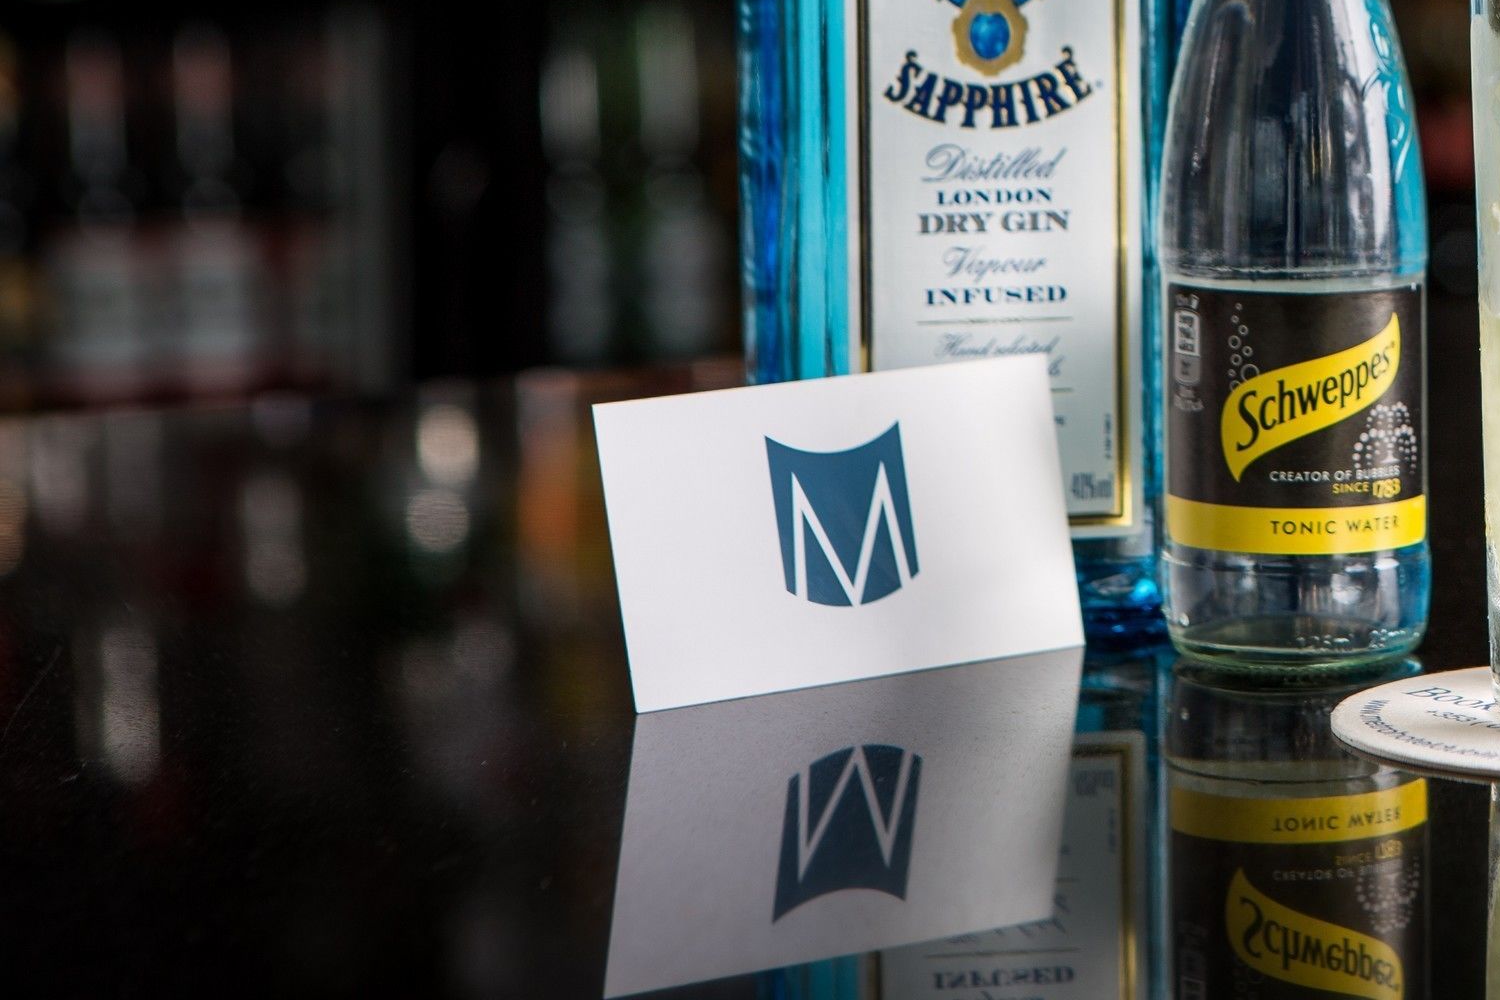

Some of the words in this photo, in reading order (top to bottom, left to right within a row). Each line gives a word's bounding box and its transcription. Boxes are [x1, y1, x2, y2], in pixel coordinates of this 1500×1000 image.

[883, 46, 1092, 129] SAPPHIRE
[922, 143, 1068, 183] Distilled
[936, 188, 1054, 206] LONDON
[917, 213, 993, 236] DRY
[1000, 209, 1071, 233] GIN
[942, 245, 1049, 282] Vapour
[924, 284, 1069, 307] INFUSED
[1236, 346, 1390, 452] Schweppes
[1269, 470, 1330, 481] CREATOR
[1333, 470, 1353, 481] OF
[1332, 481, 1370, 494] SINCE
[1270, 520, 1337, 535] TONIC
[1346, 515, 1399, 533] WATER
